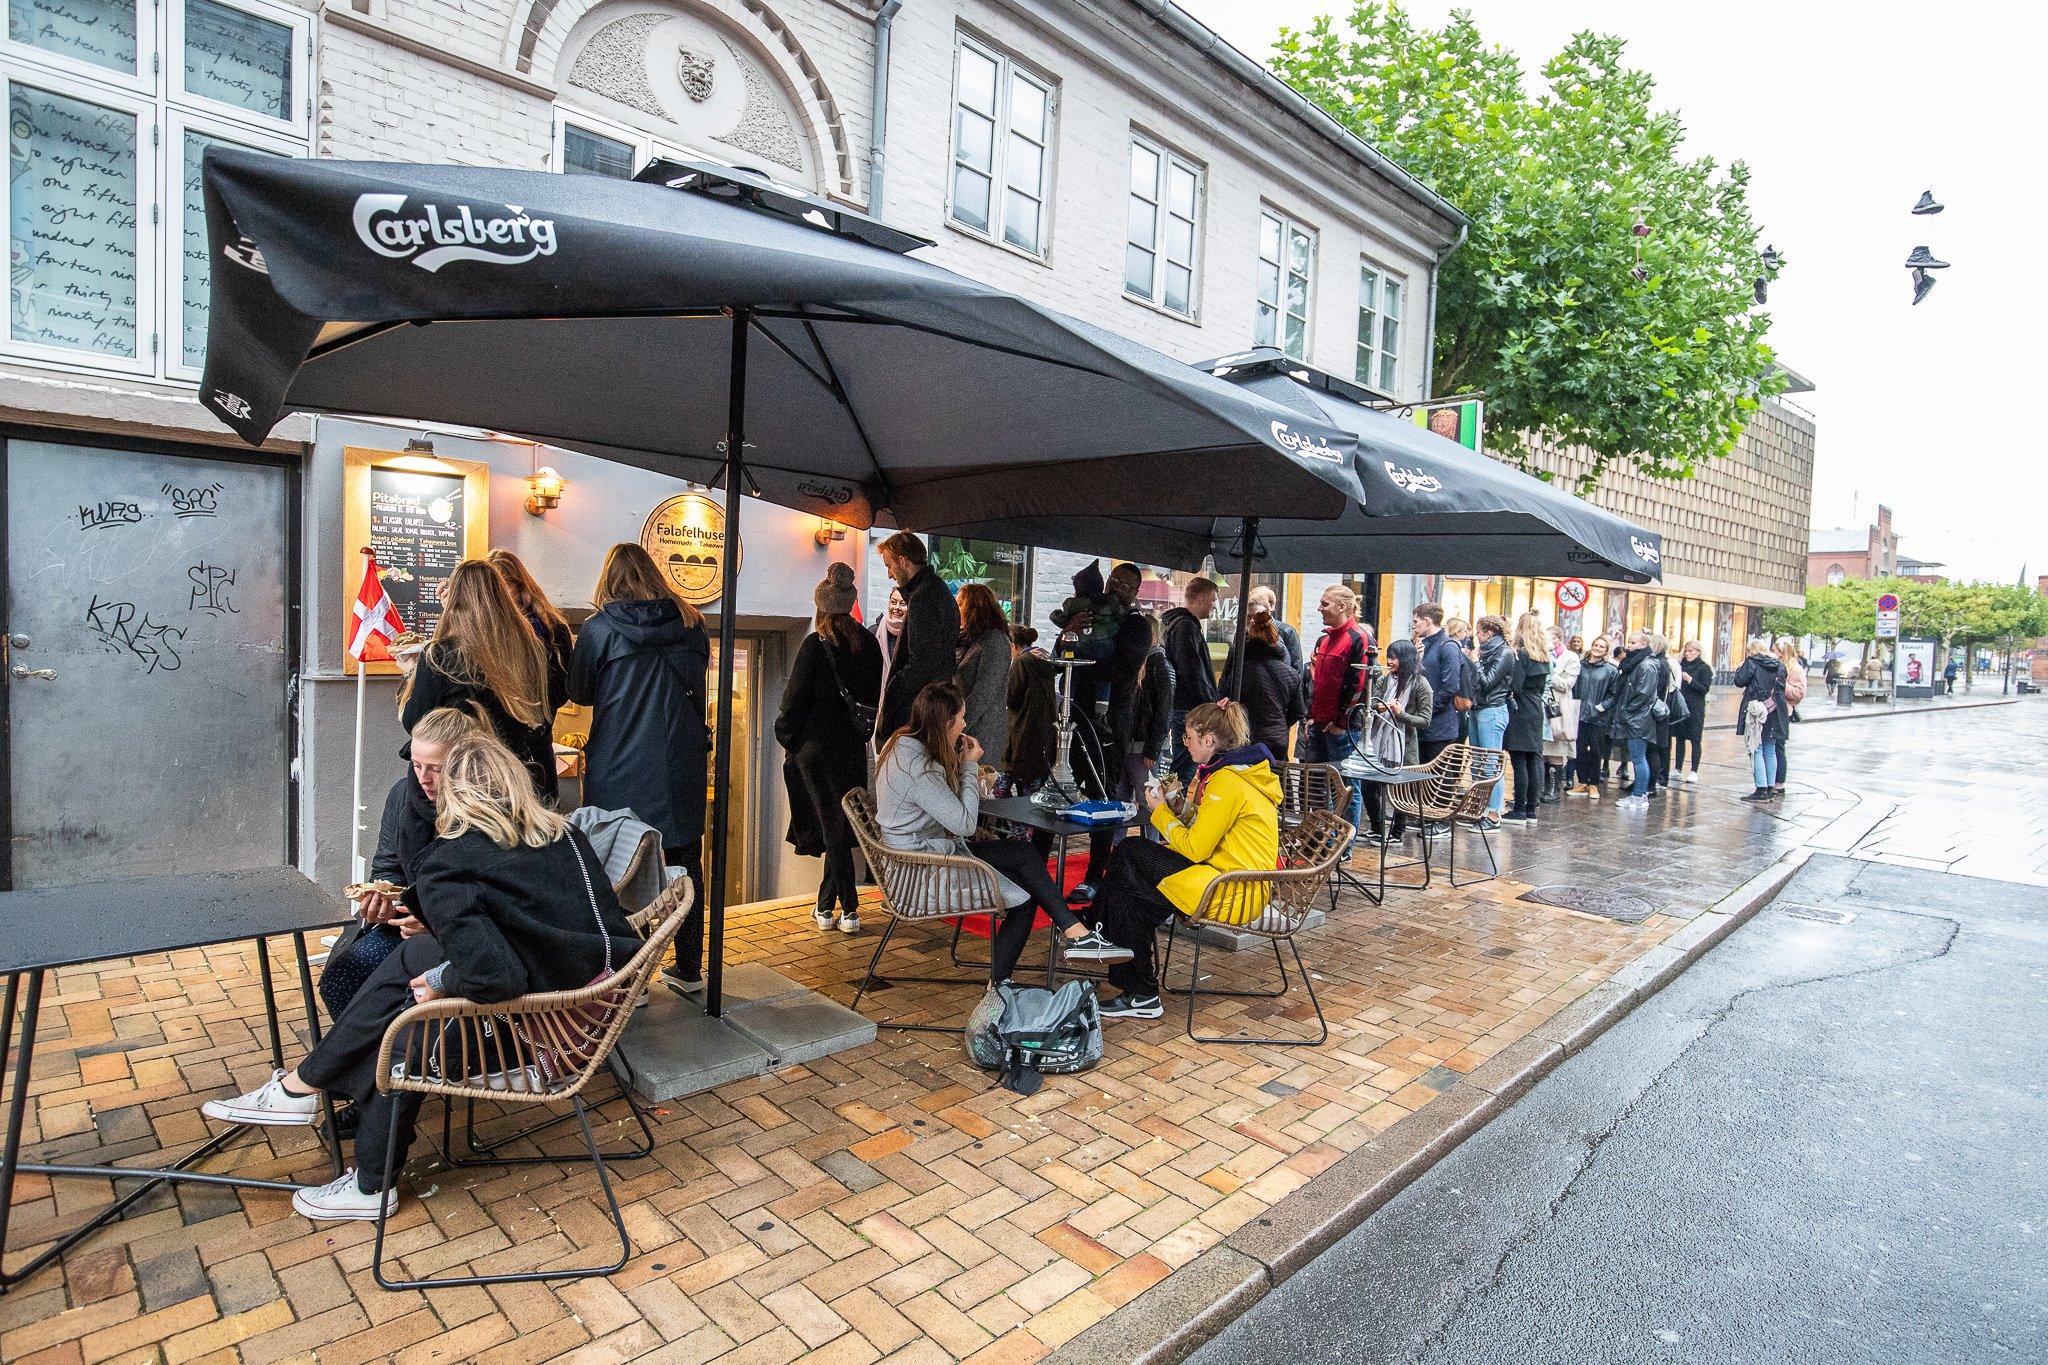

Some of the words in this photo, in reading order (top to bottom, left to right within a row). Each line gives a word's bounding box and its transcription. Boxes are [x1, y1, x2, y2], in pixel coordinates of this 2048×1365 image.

[62, 130, 121, 164] twenty
[43, 177, 72, 191] one
[41, 203, 98, 225] eight
[352, 192, 558, 262] Carlsberg
[35, 250, 102, 277] fourteen
[64, 282, 112, 312] thirty
[48, 304, 106, 330] ninety
[37, 327, 81, 344] three
[1271, 419, 1344, 465] Carlsberg
[1384, 460, 1443, 493] Carlsberg
[656, 522, 725, 541] Falafelhuse
[699, 541, 725, 549] Takeawa
